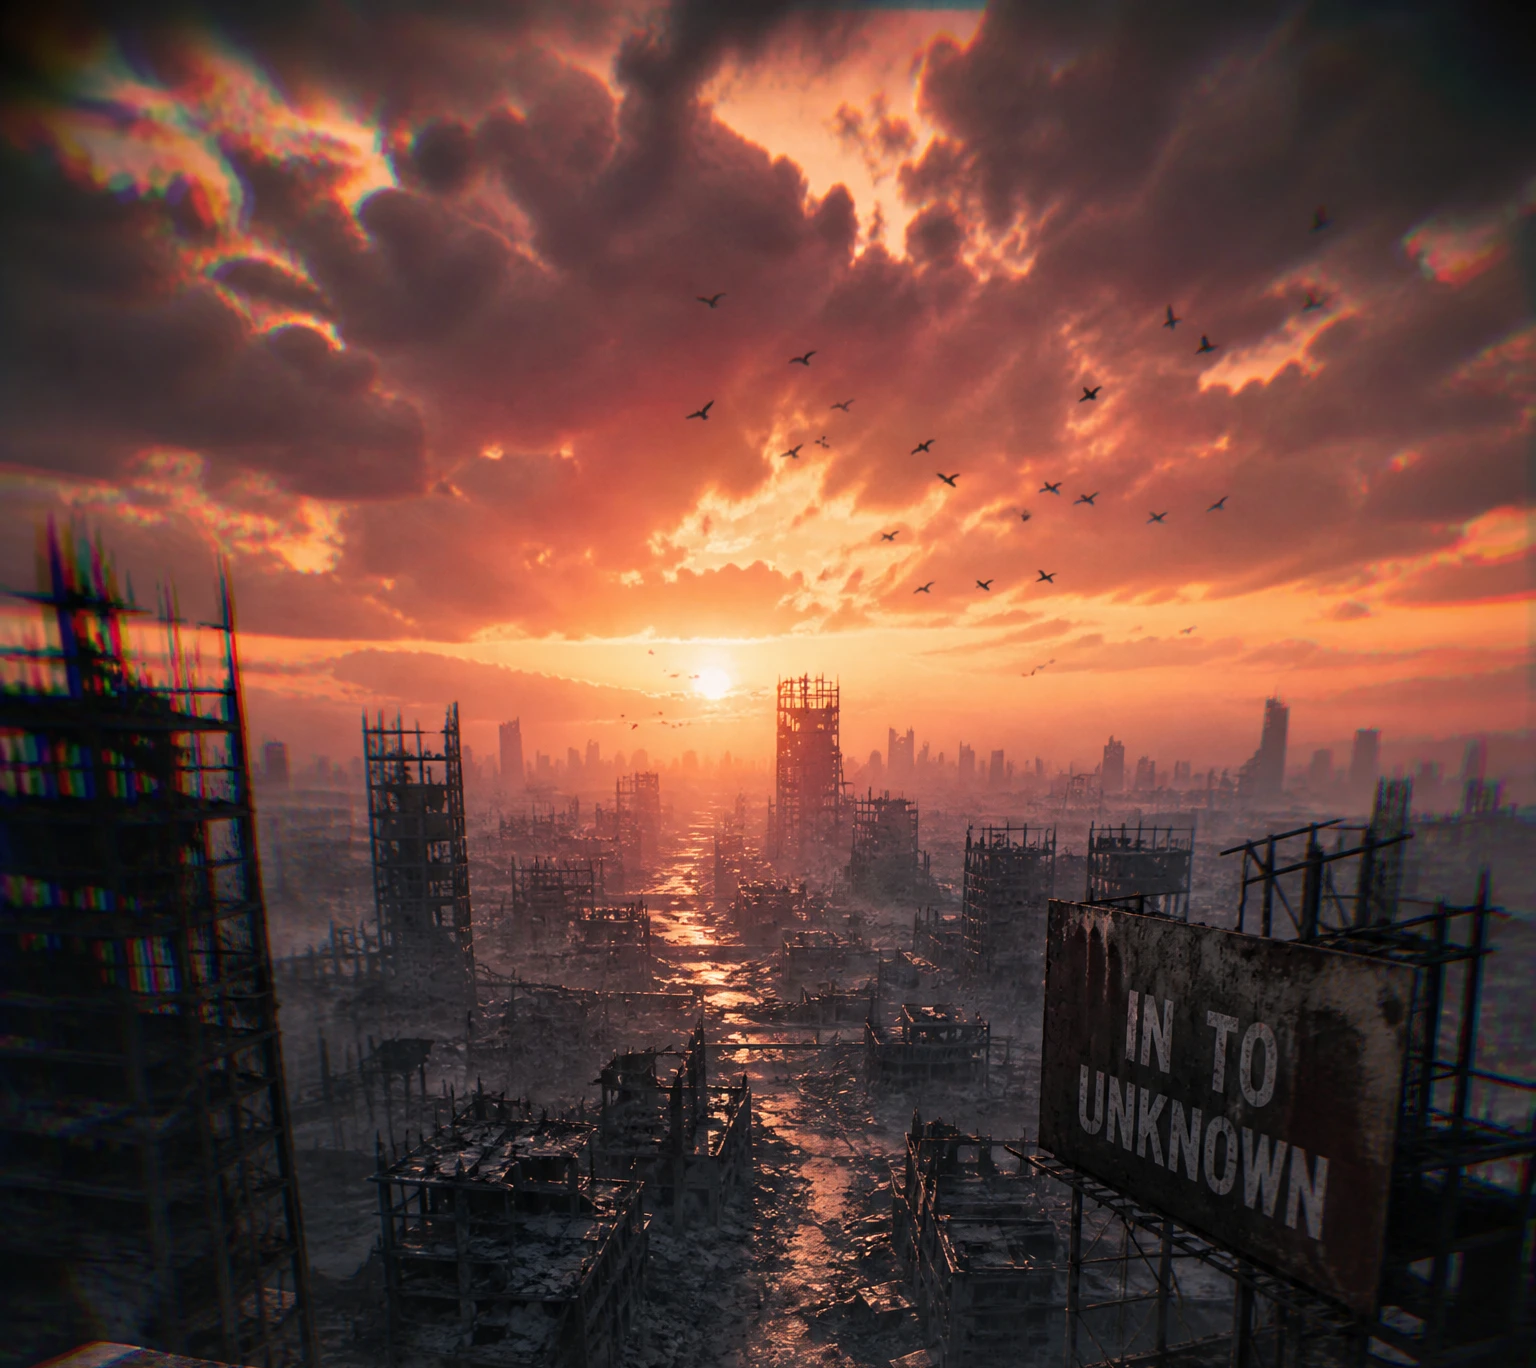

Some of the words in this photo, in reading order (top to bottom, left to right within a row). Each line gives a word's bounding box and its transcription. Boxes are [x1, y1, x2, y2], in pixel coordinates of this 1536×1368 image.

[1125, 989, 1174, 1074] IN
[1206, 1010, 1278, 1108] TO
[1078, 1063, 1330, 1241] UNKNOWN
